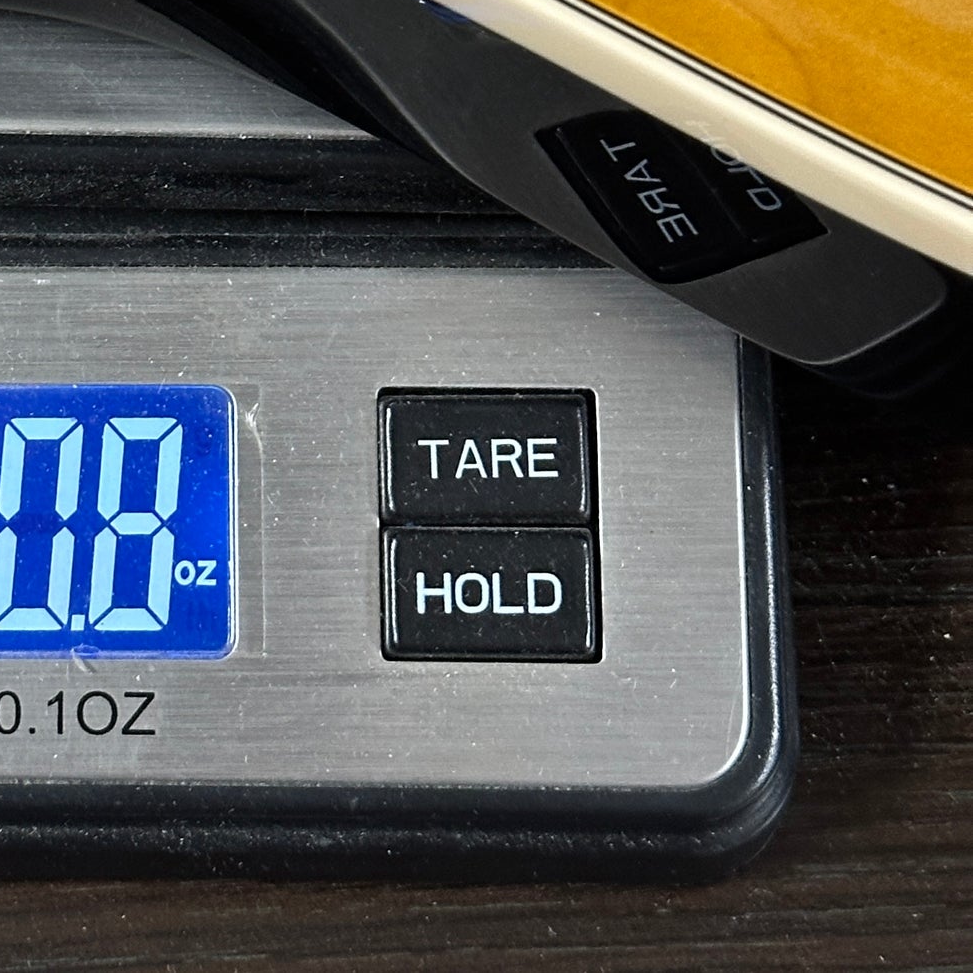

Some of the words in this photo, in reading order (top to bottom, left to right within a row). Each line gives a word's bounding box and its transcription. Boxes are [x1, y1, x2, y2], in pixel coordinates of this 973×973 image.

[417, 438, 559, 479] TARE
[174, 560, 217, 585] oz
[416, 572, 562, 614] HOLD
